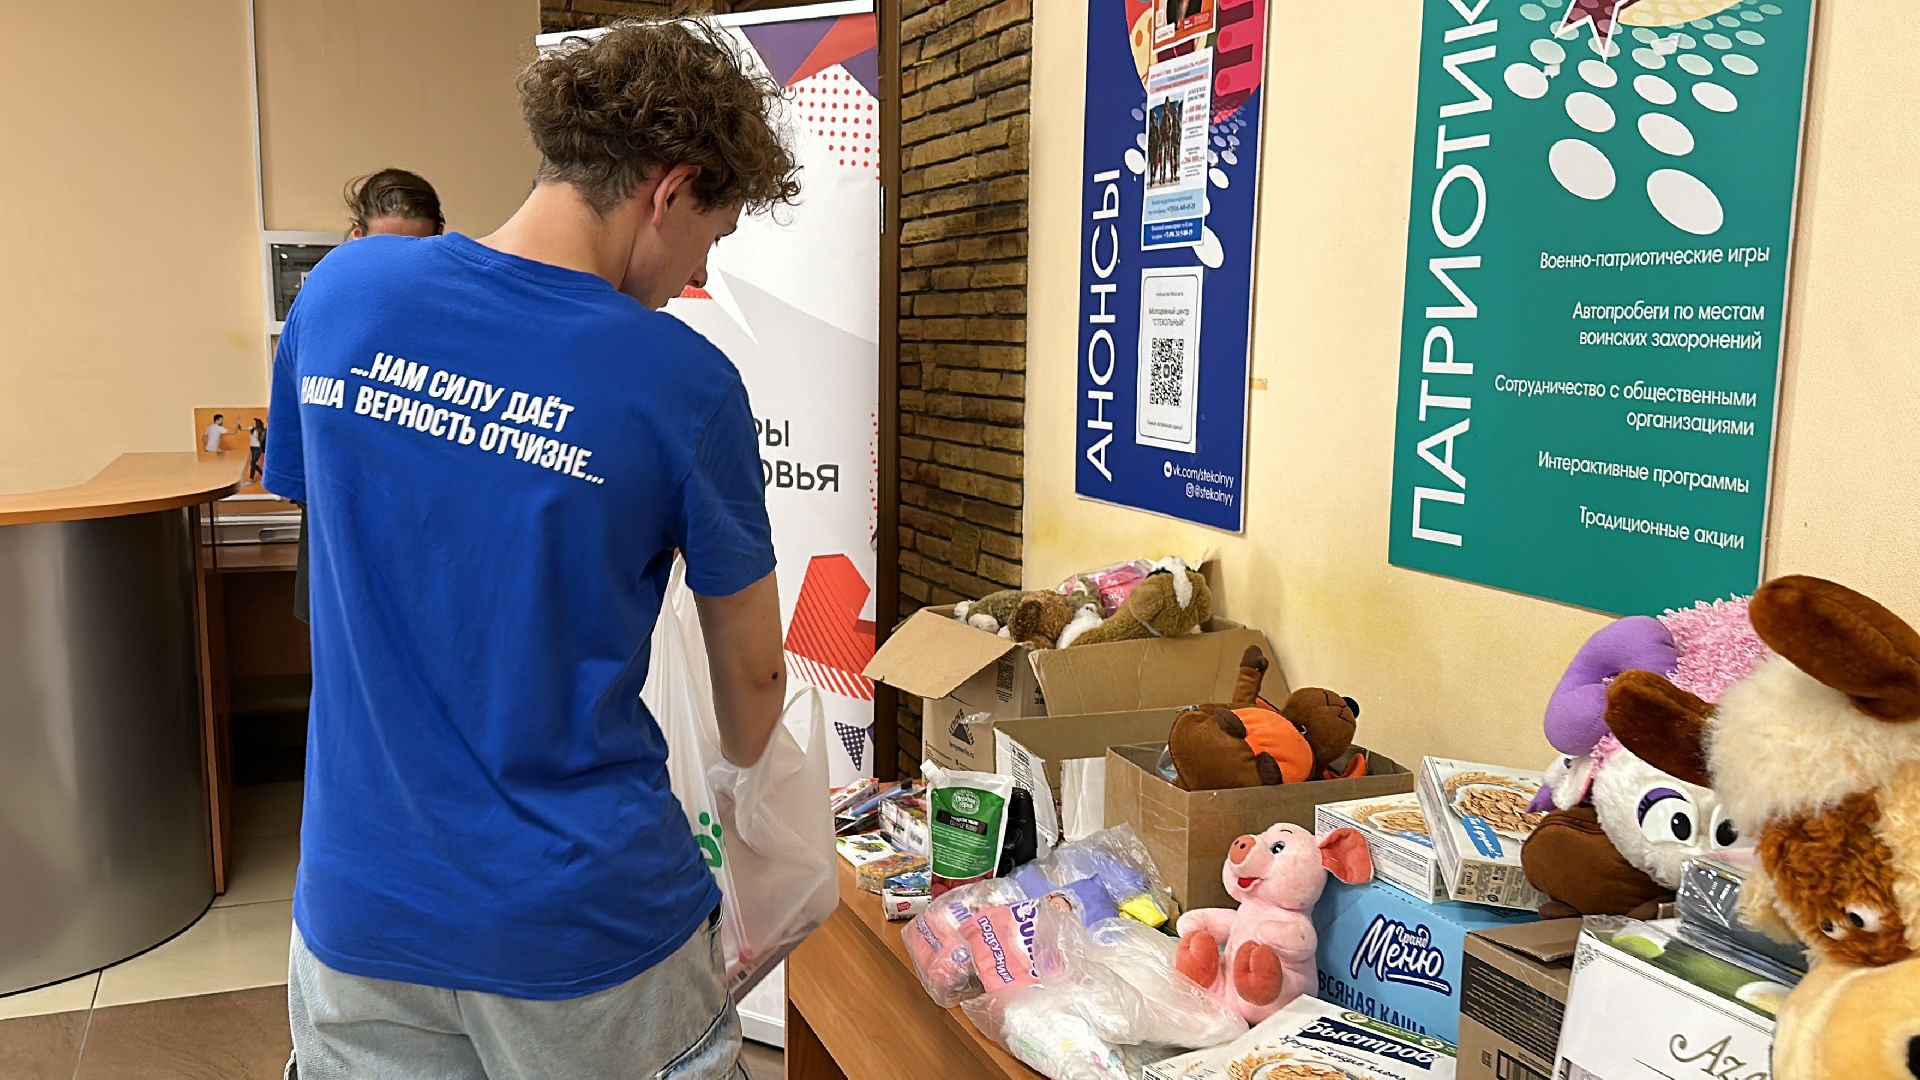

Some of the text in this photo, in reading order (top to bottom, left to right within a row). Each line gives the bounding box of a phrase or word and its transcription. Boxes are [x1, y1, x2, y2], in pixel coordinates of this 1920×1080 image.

[1539, 246, 1770, 271] Военно-патриотические игры
[1086, 169, 1121, 483] АНОНСЫ
[1572, 300, 1765, 324] Автопробеги по местам
[1579, 330, 1763, 352] воинских захоронений
[350, 351, 575, 433] ...НАМ СИЛУ ДАЁТ
[1494, 374, 1757, 408] Сотрудничество с общественными
[353, 385, 476, 447] ВЕРНОСТЬ
[479, 421, 605, 485] ОТЧИЗНЕ...
[1626, 411, 1755, 436] организациями
[1538, 450, 1750, 494] Интерактивные программы
[1579, 505, 1745, 550] Традиционные акции
[1352, 917, 1442, 979] Меню
[1319, 969, 1376, 1018] ВСЯНАЯ
[1302, 1021, 1439, 1064] Быстров
